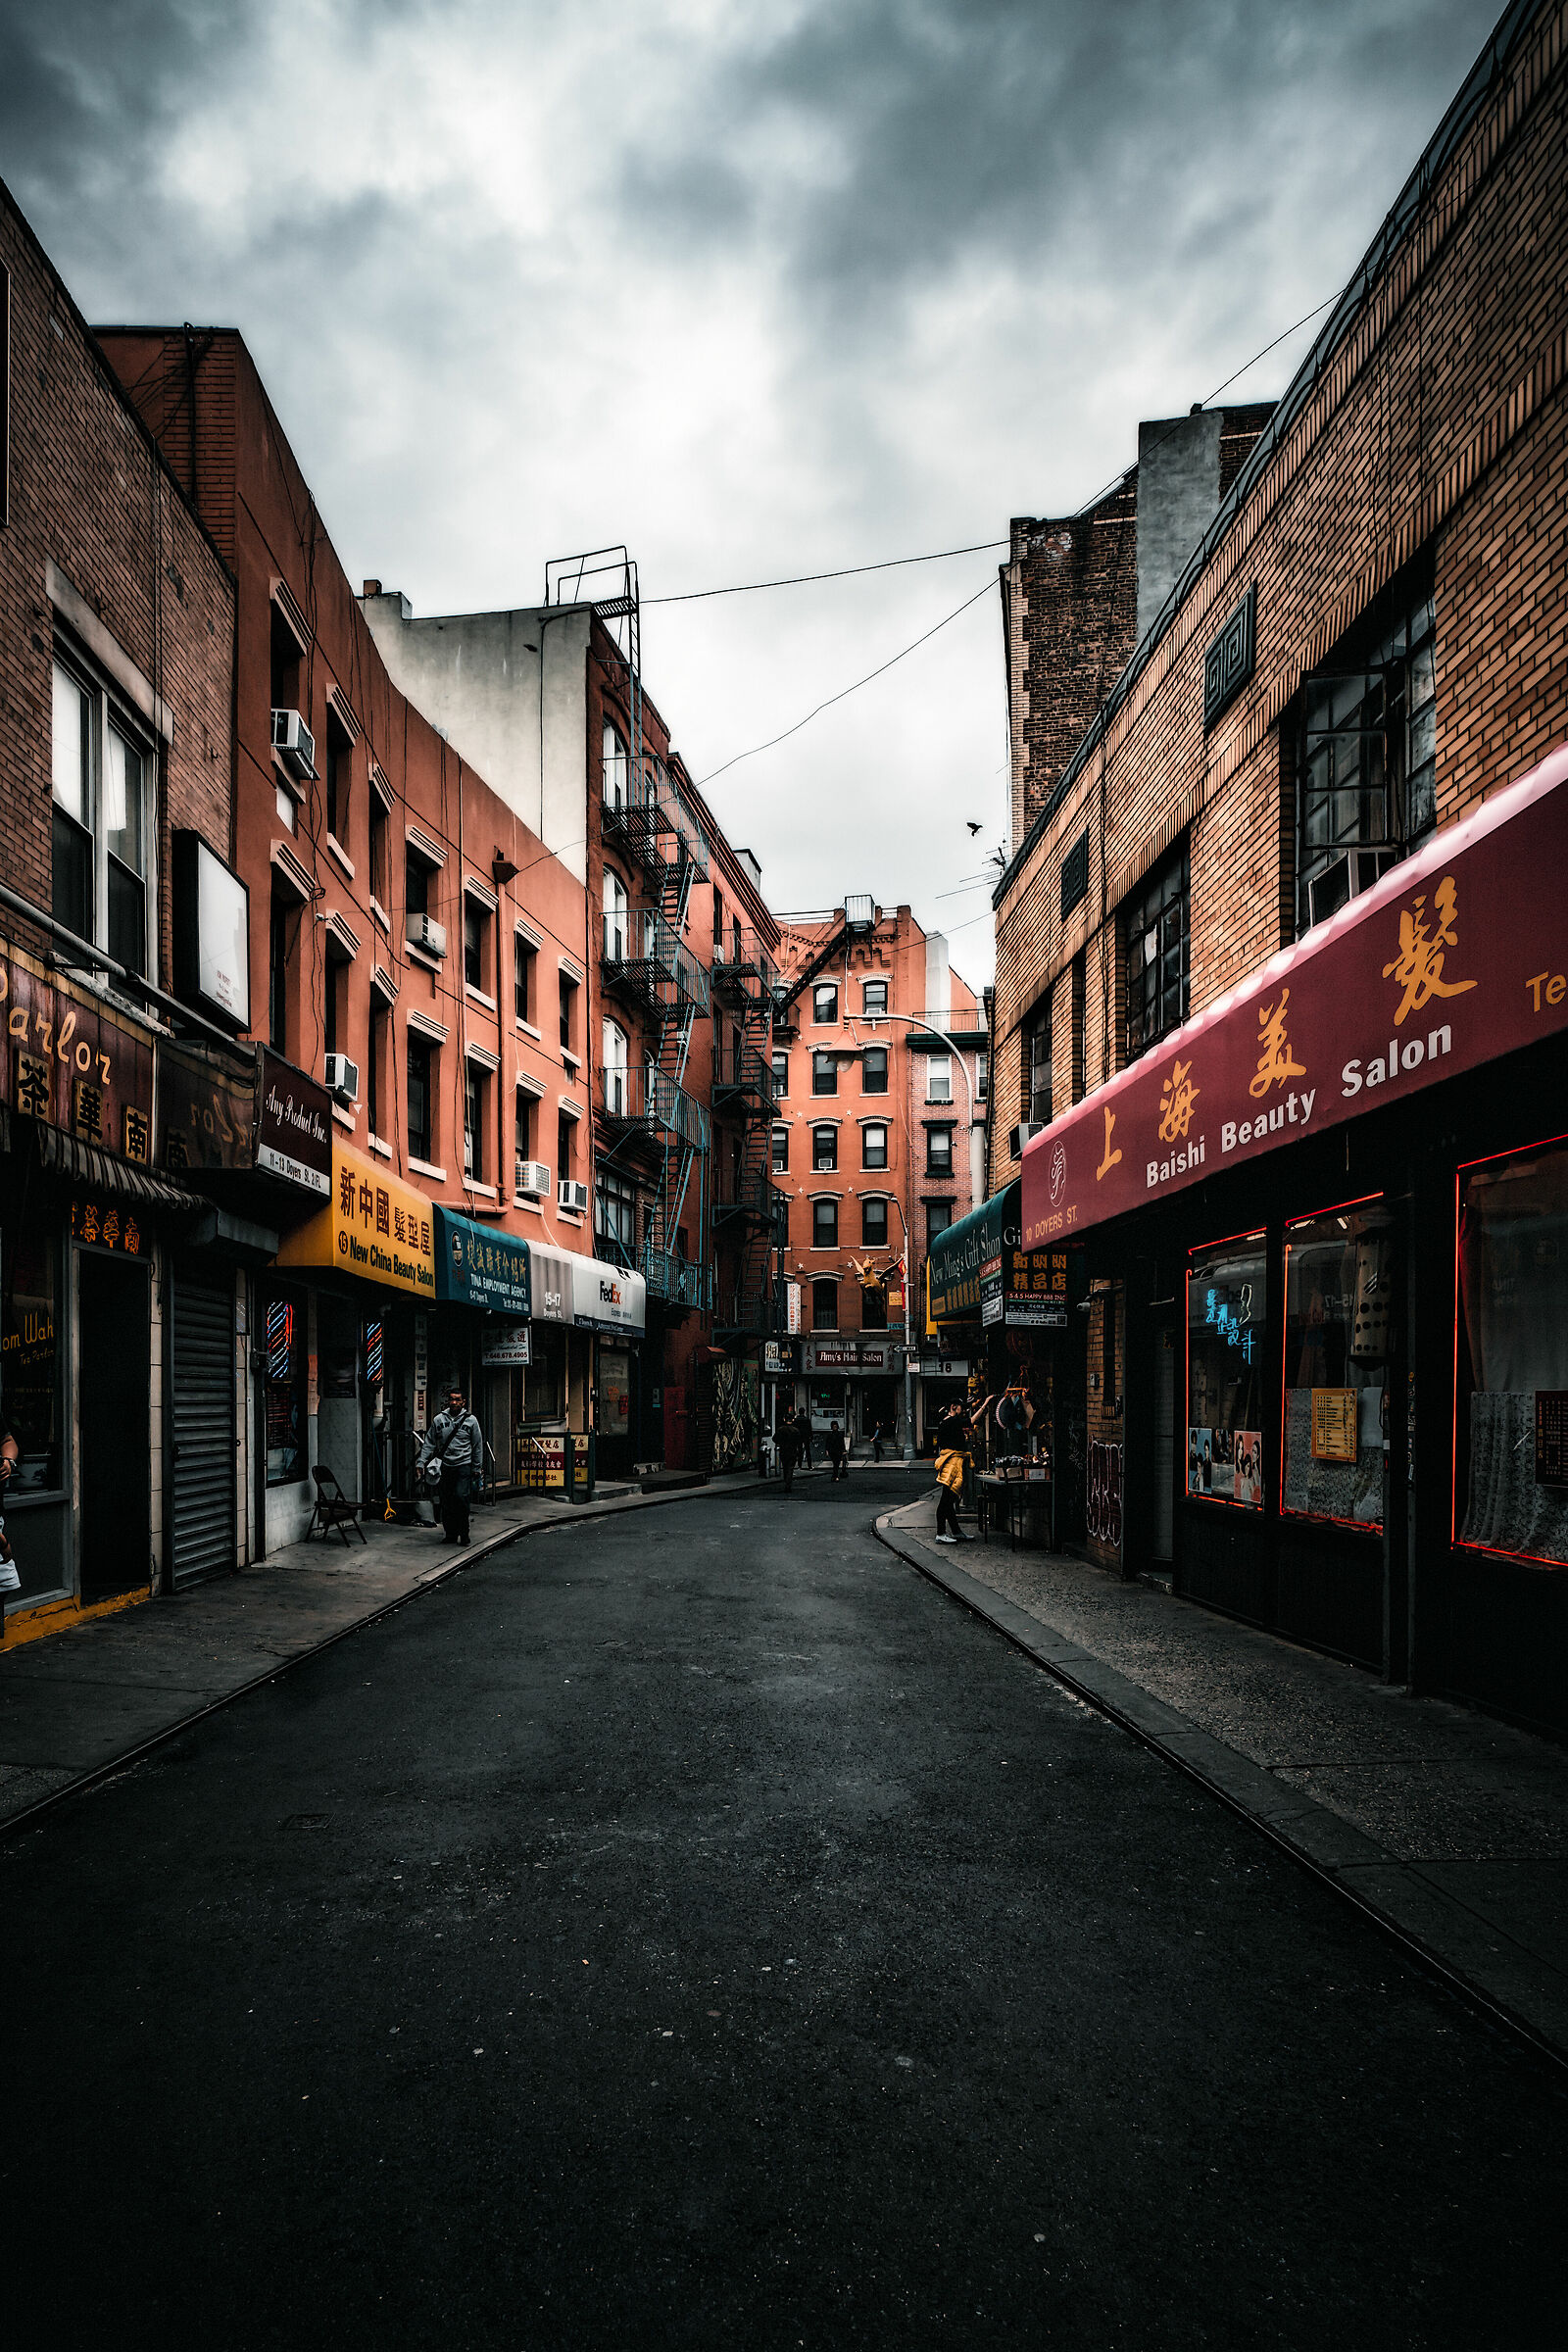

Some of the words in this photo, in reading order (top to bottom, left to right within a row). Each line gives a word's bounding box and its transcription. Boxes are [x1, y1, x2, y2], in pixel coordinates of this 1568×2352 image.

[266, 1085, 283, 1126] Any
[284, 1095, 313, 1135] Product
[313, 1113, 327, 1144] Inc.
[1146, 1134, 1205, 1188] Baishi
[1220, 1086, 1316, 1153] Beauty
[1341, 1024, 1451, 1098] Salon
[286, 1159, 302, 1181] Doyers
[1035, 1213, 1063, 1239] DOYERS
[1066, 1204, 1078, 1225] ST.
[350, 1235, 368, 1264] New
[370, 1245, 392, 1273] China
[393, 1254, 416, 1285] Beauty
[416, 1263, 433, 1287] Salon
[931, 1258, 943, 1286] New
[964, 1228, 980, 1270] Gift
[981, 1222, 1001, 1261] Shop
[483, 1277, 511, 1295] EMPLOYMENT
[511, 1284, 526, 1298] AGENCY
[600, 1280, 621, 1304] FedEx
[24, 1311, 54, 1344] Wah
[820, 1351, 841, 1363] Amy's
[843, 1351, 858, 1362] Hair
[862, 1352, 882, 1362] Salon
